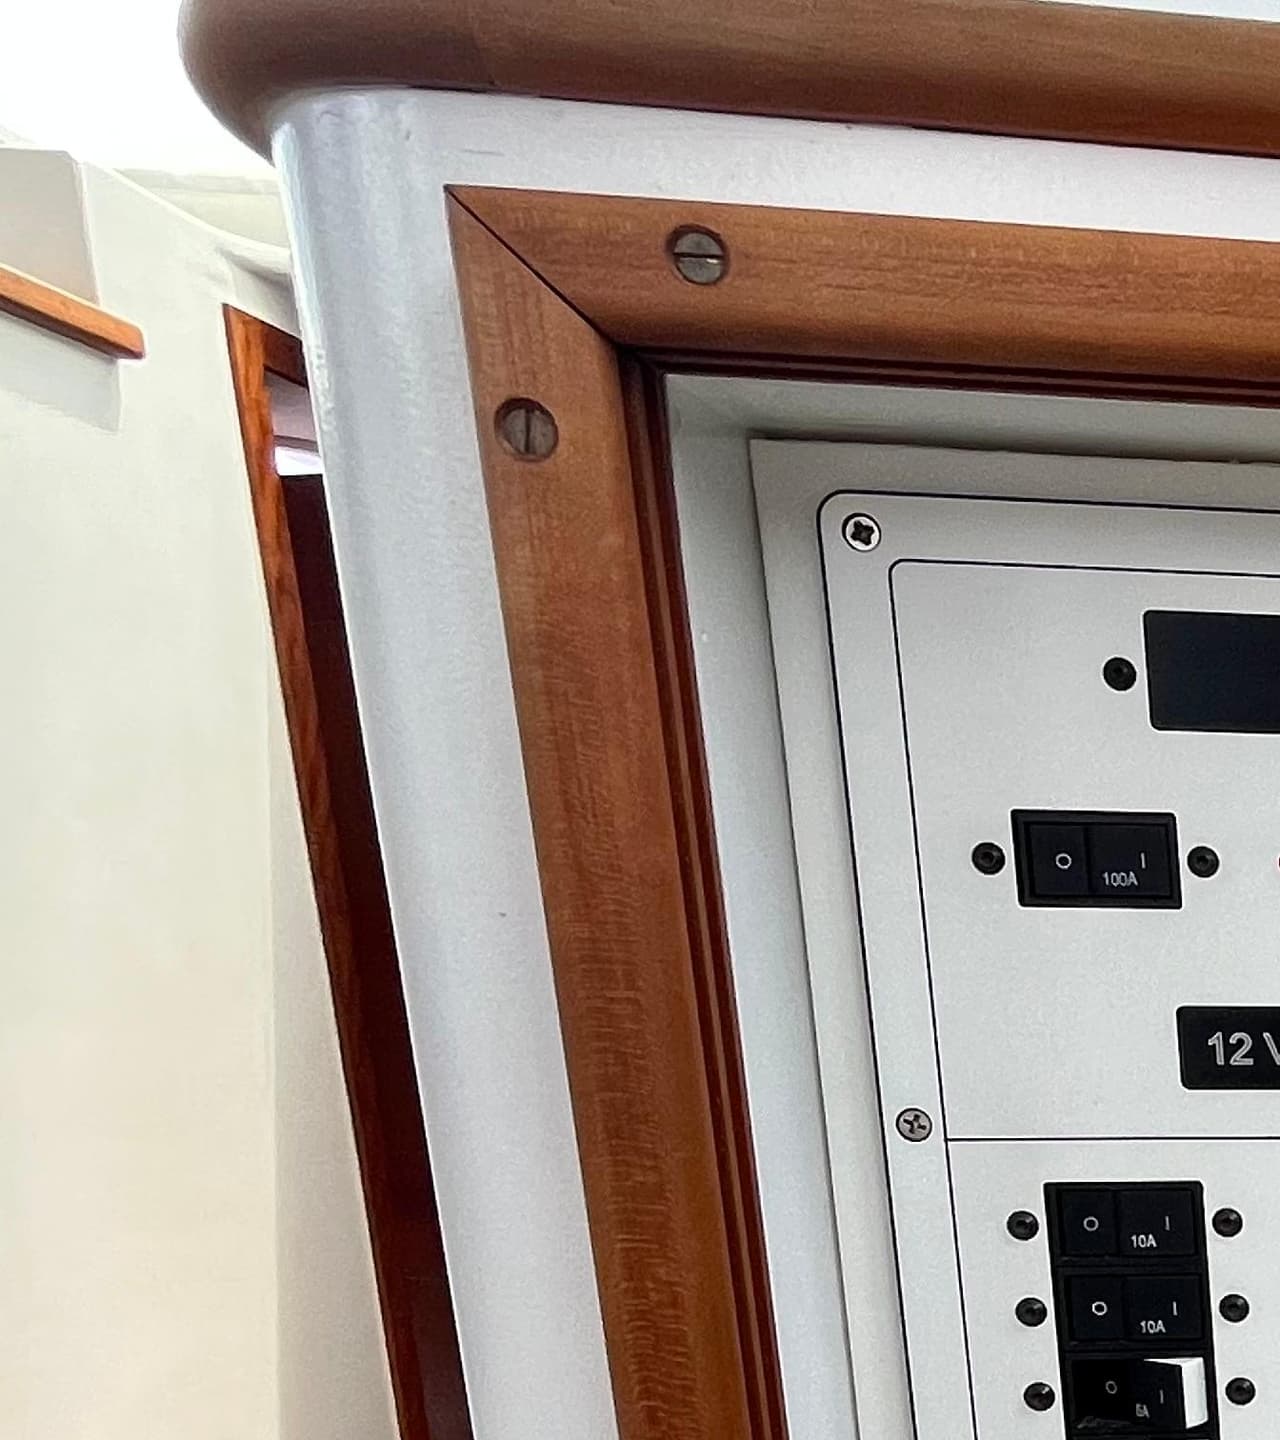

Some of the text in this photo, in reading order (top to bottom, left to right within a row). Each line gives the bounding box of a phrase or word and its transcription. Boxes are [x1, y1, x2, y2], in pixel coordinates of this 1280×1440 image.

[1104, 872, 1138, 887] 100A
[1208, 1032, 1253, 1065] 12
[1132, 1234, 1156, 1247] 10A
[1141, 1320, 1165, 1333] 10A
